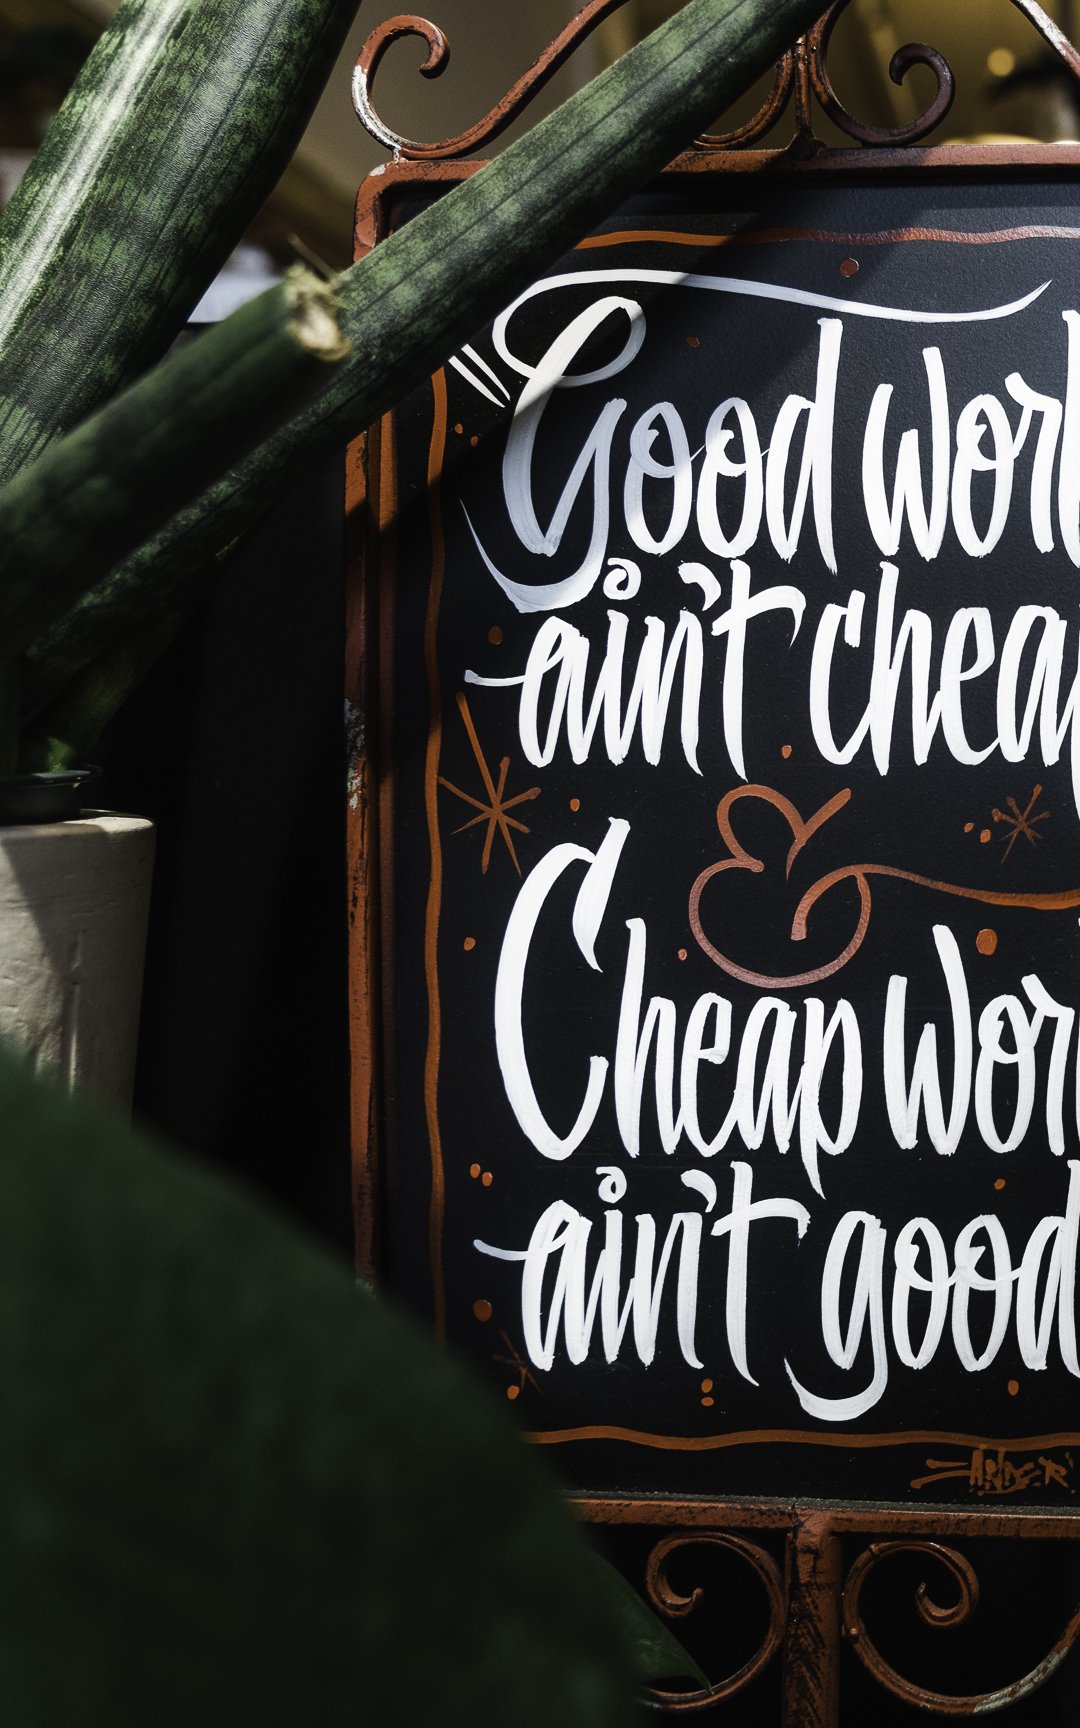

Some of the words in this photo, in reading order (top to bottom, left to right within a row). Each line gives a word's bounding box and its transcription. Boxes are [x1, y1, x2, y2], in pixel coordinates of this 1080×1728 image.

[465, 556, 806, 783] ain't
[494, 816, 863, 1200] Cheap
[473, 1160, 811, 1388] ain't
